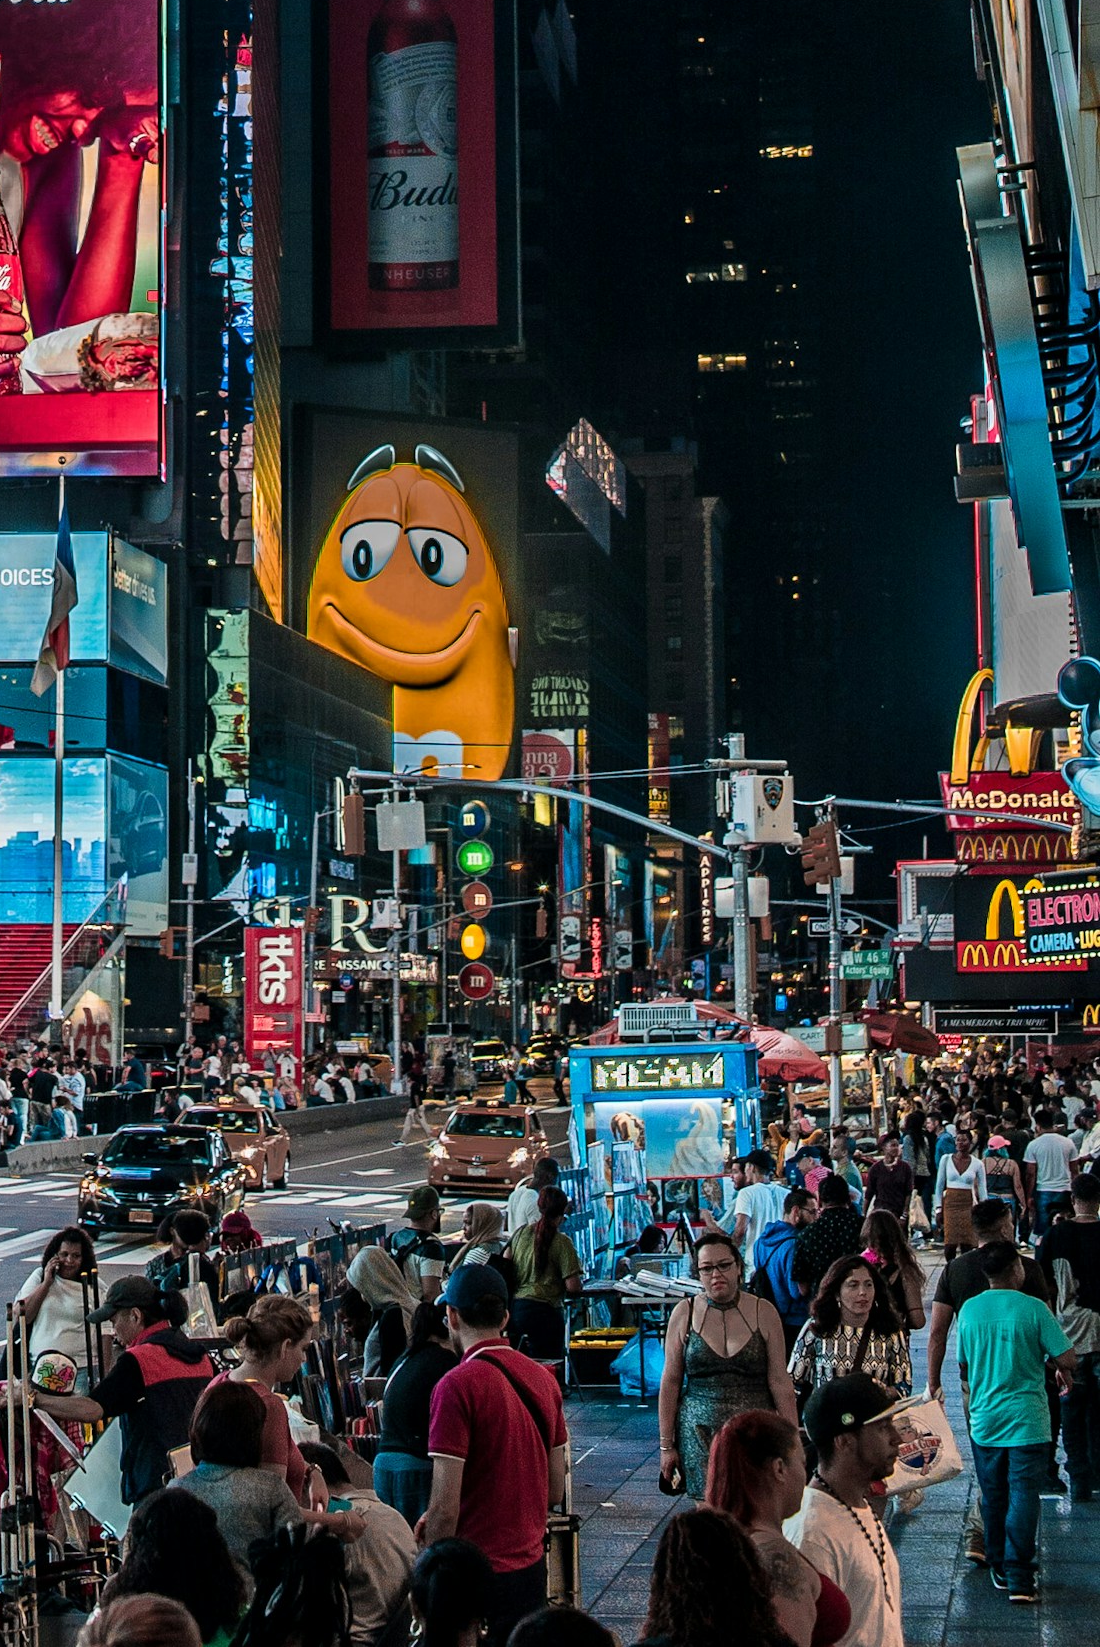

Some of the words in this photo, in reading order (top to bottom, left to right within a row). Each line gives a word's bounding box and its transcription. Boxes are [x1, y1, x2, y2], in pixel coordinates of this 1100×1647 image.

[1030, 932, 1075, 953] CAMERA
[854, 953, 863, 963] W
[866, 951, 879, 964] 46
[258, 933, 294, 1005] tkts
[869, 965, 890, 976] Equity
